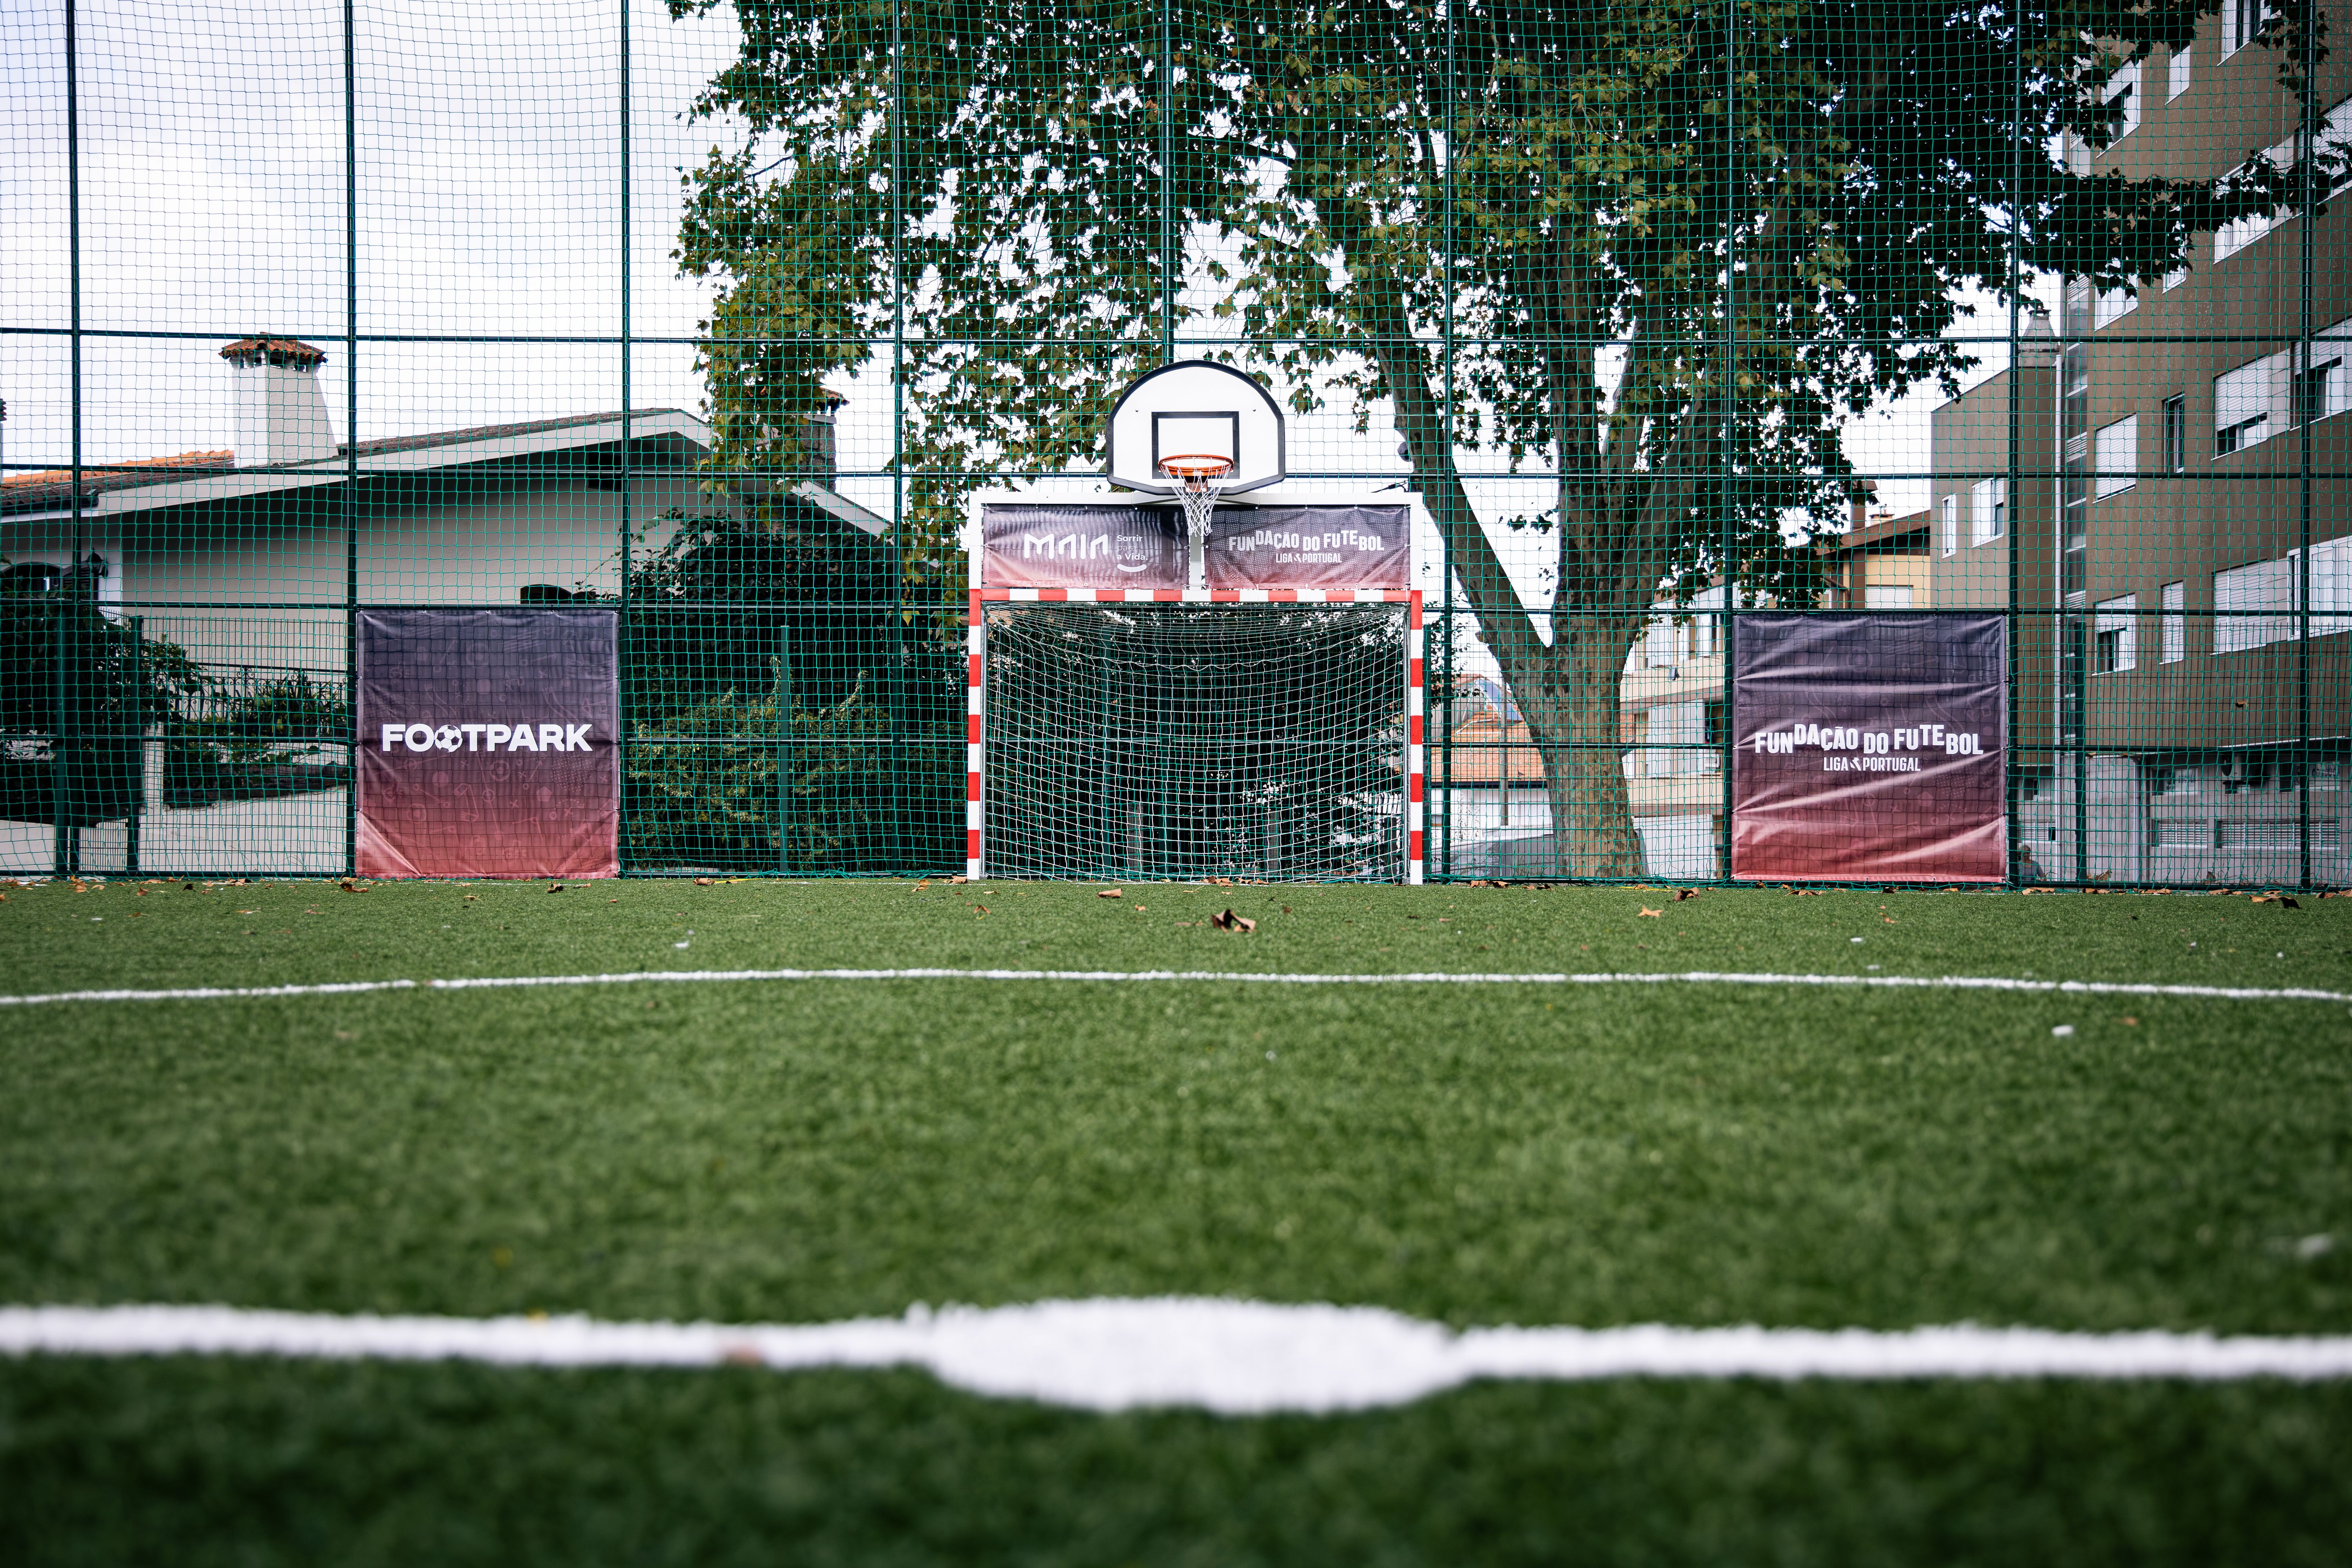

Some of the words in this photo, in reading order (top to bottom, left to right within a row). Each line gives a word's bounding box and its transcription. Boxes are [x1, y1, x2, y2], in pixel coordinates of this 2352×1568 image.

[1229, 530, 1299, 551] FUNDAÇÃO
[1303, 536, 1320, 551] DO
[1323, 530, 1385, 551] FUTEBOL
[1276, 554, 1293, 563] LIGA
[1303, 553, 1342, 563] PORTUGAL
[1755, 724, 1858, 753] FUNDAÇÃO
[1864, 732, 1889, 754] DO
[1894, 724, 1984, 755] FUTEBOL
[1824, 757, 1848, 771] LIGA
[1863, 757, 1921, 771] PORTUGAL
